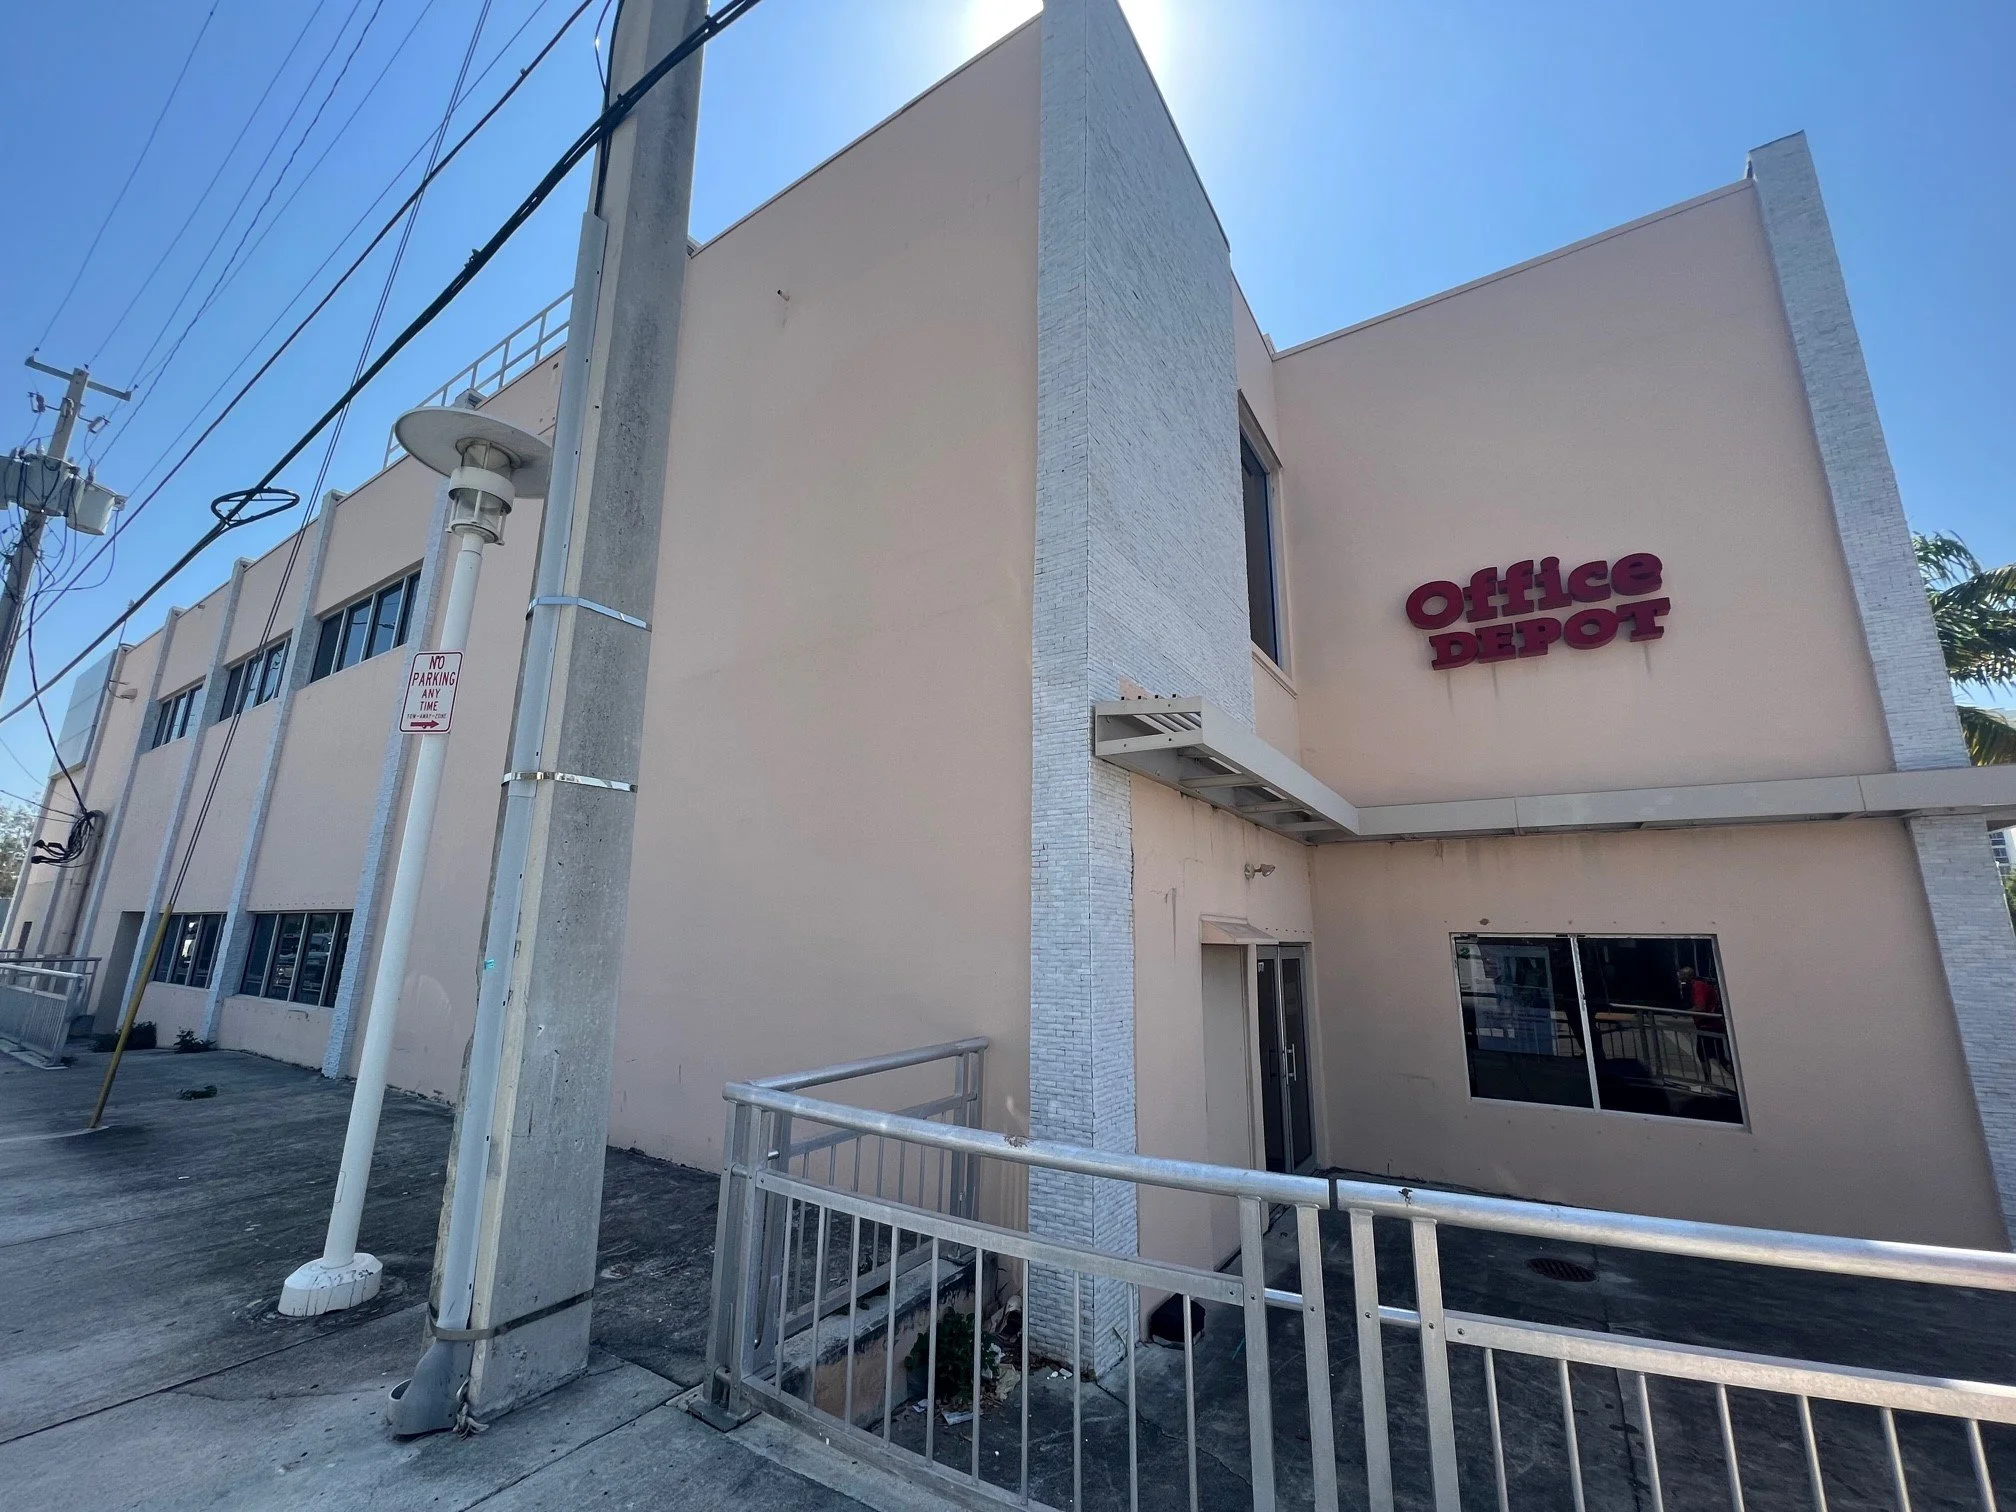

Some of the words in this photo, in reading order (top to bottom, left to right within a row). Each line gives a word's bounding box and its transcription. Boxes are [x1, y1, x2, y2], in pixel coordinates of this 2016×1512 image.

[1406, 552, 1663, 630] Office
[1429, 597, 1671, 670] DEPOT
[429, 656, 445, 669] NO
[412, 672, 456, 686] PARKING
[421, 688, 441, 699] ANY
[420, 700, 439, 711] TIME
